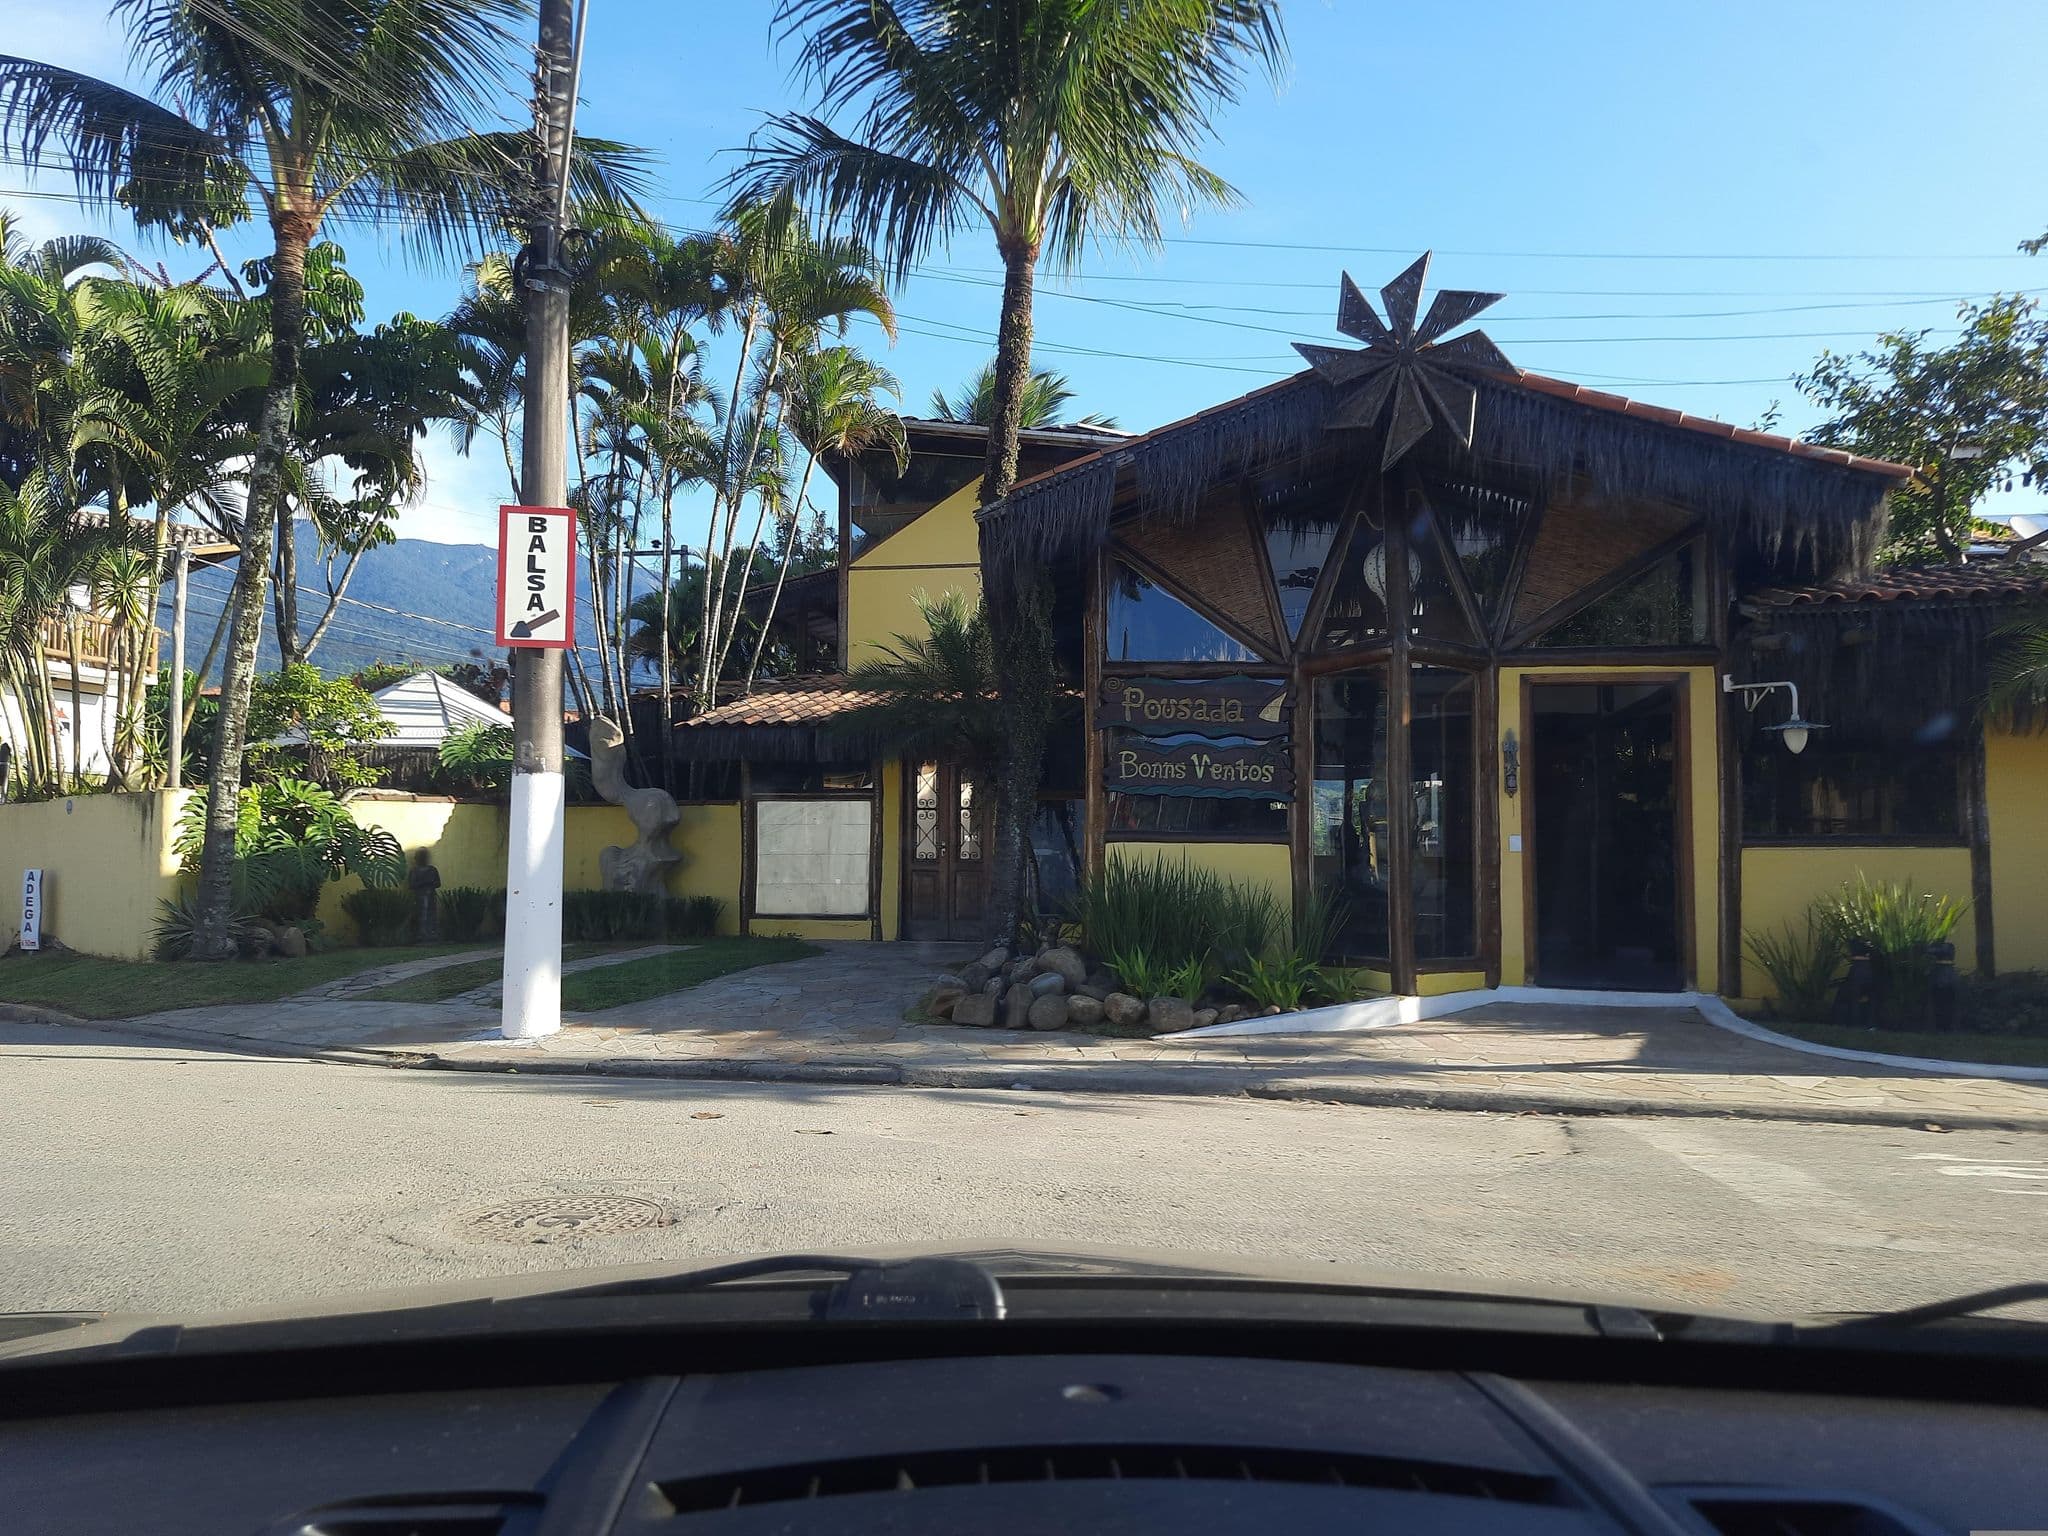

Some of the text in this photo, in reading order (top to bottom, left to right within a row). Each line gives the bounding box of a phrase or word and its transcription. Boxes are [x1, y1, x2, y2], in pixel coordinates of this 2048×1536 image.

[526, 516, 548, 612] BALSA
[1121, 687, 1244, 722] Pousada
[1190, 753, 1275, 783] Ventos
[24, 871, 35, 933] ADEGA
